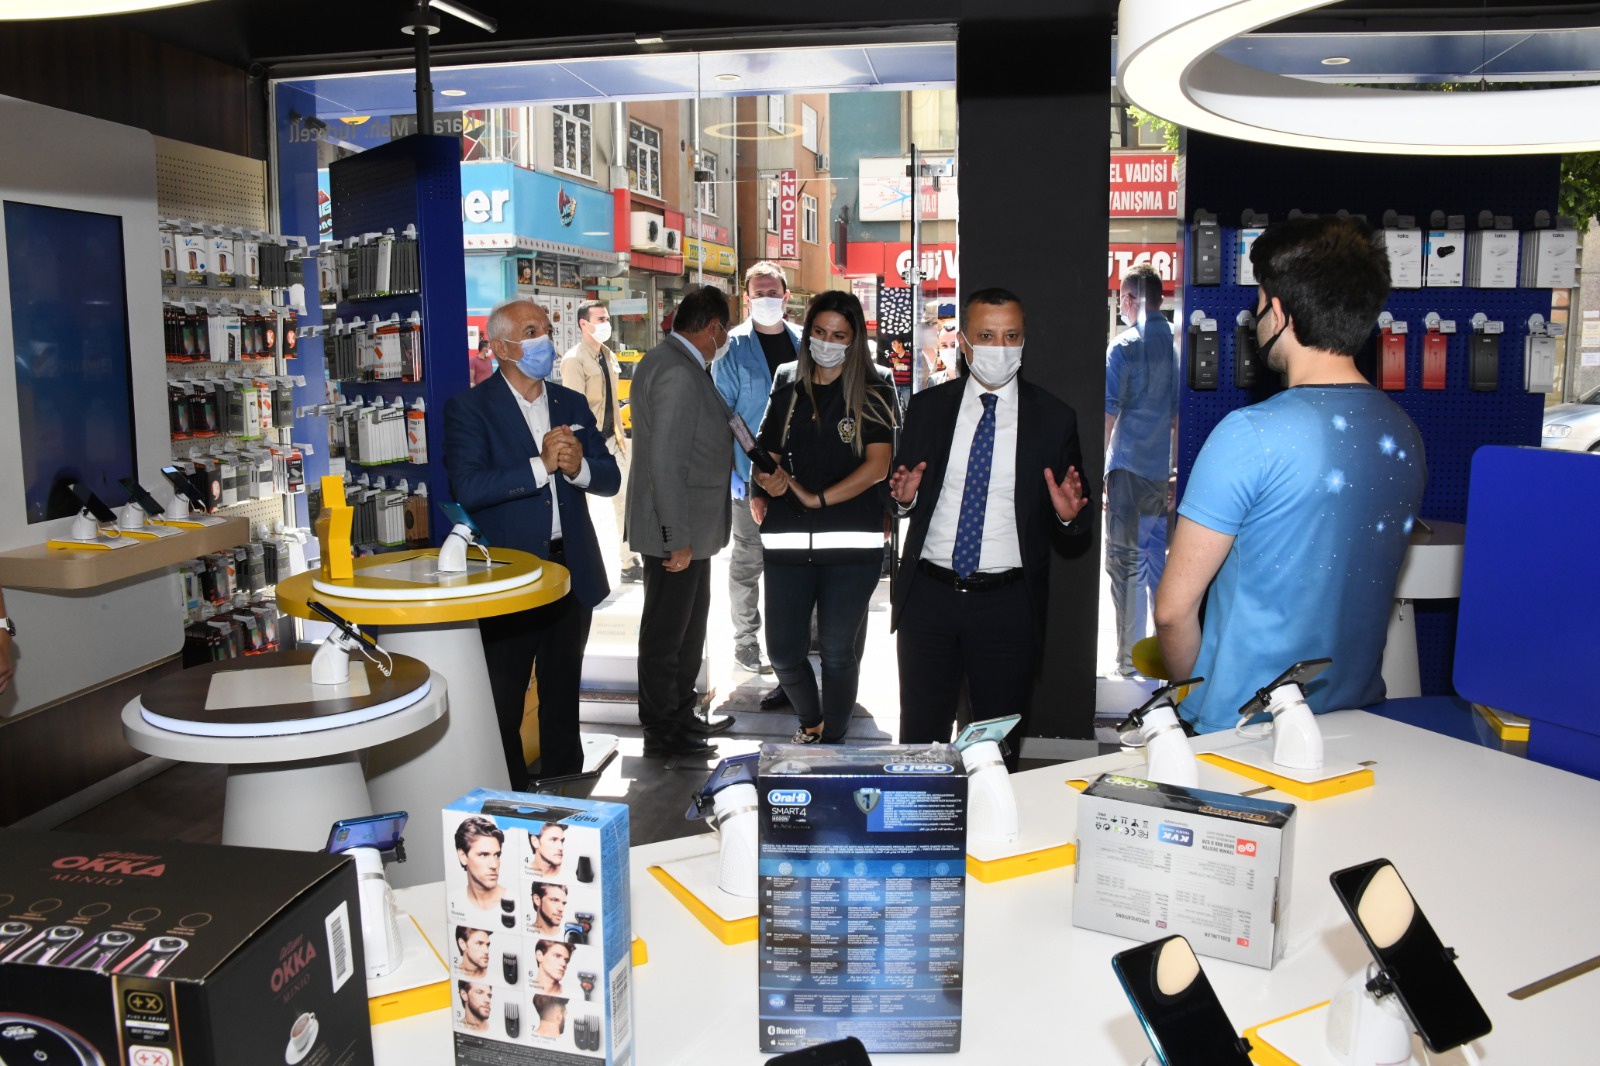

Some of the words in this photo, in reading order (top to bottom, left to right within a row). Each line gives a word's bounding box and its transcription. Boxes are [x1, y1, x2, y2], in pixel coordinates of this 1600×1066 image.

[1125, 159, 1168, 183] VADİSİ
[462, 189, 510, 223] er
[781, 184, 796, 255] NOTER
[771, 792, 807, 803] Oral-B
[771, 807, 799, 816] SMART
[799, 807, 807, 817] 4
[1161, 832, 1191, 844] KVK
[52, 856, 166, 877] OKKA
[49, 873, 125, 886] MINIO
[271, 941, 317, 993] OKKA
[776, 1027, 807, 1036] Bluetooth
